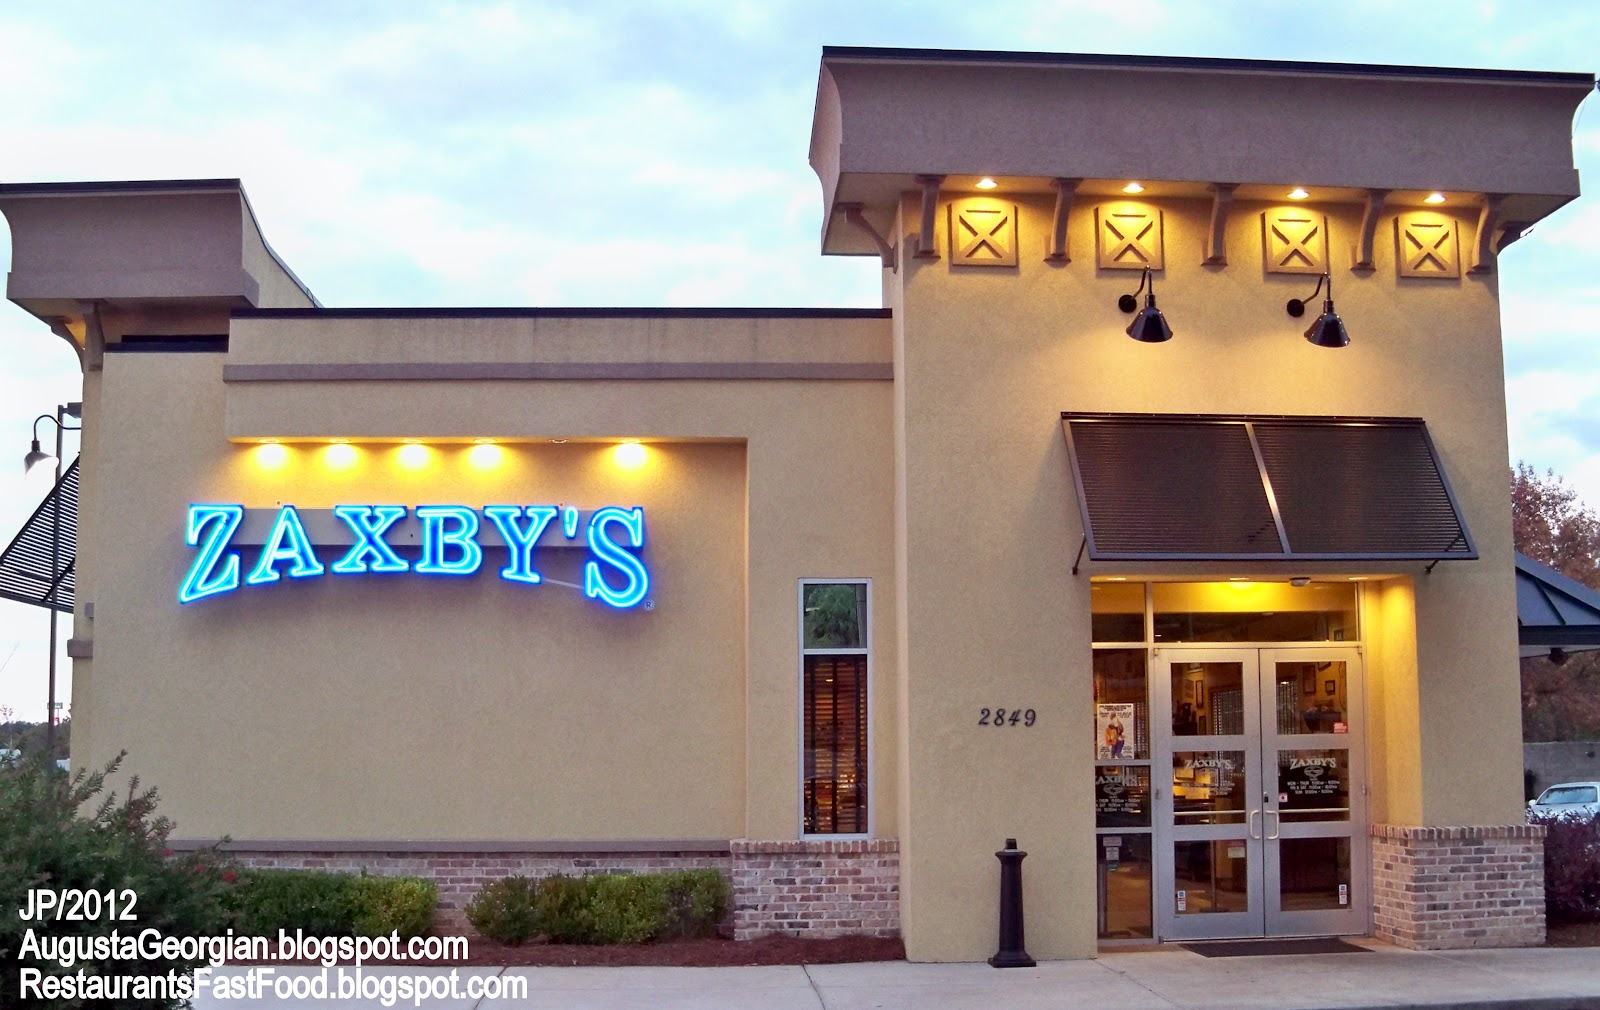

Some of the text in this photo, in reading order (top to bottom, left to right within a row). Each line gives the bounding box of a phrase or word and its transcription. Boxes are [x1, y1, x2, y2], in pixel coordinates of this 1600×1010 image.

[180, 504, 649, 608] ZAXBY'S
[978, 708, 1036, 727] 2849
[1184, 759, 1232, 770] ZAXBY'S
[1289, 757, 1337, 770] ZAXBY'S
[1095, 774, 1137, 787] AXBS
